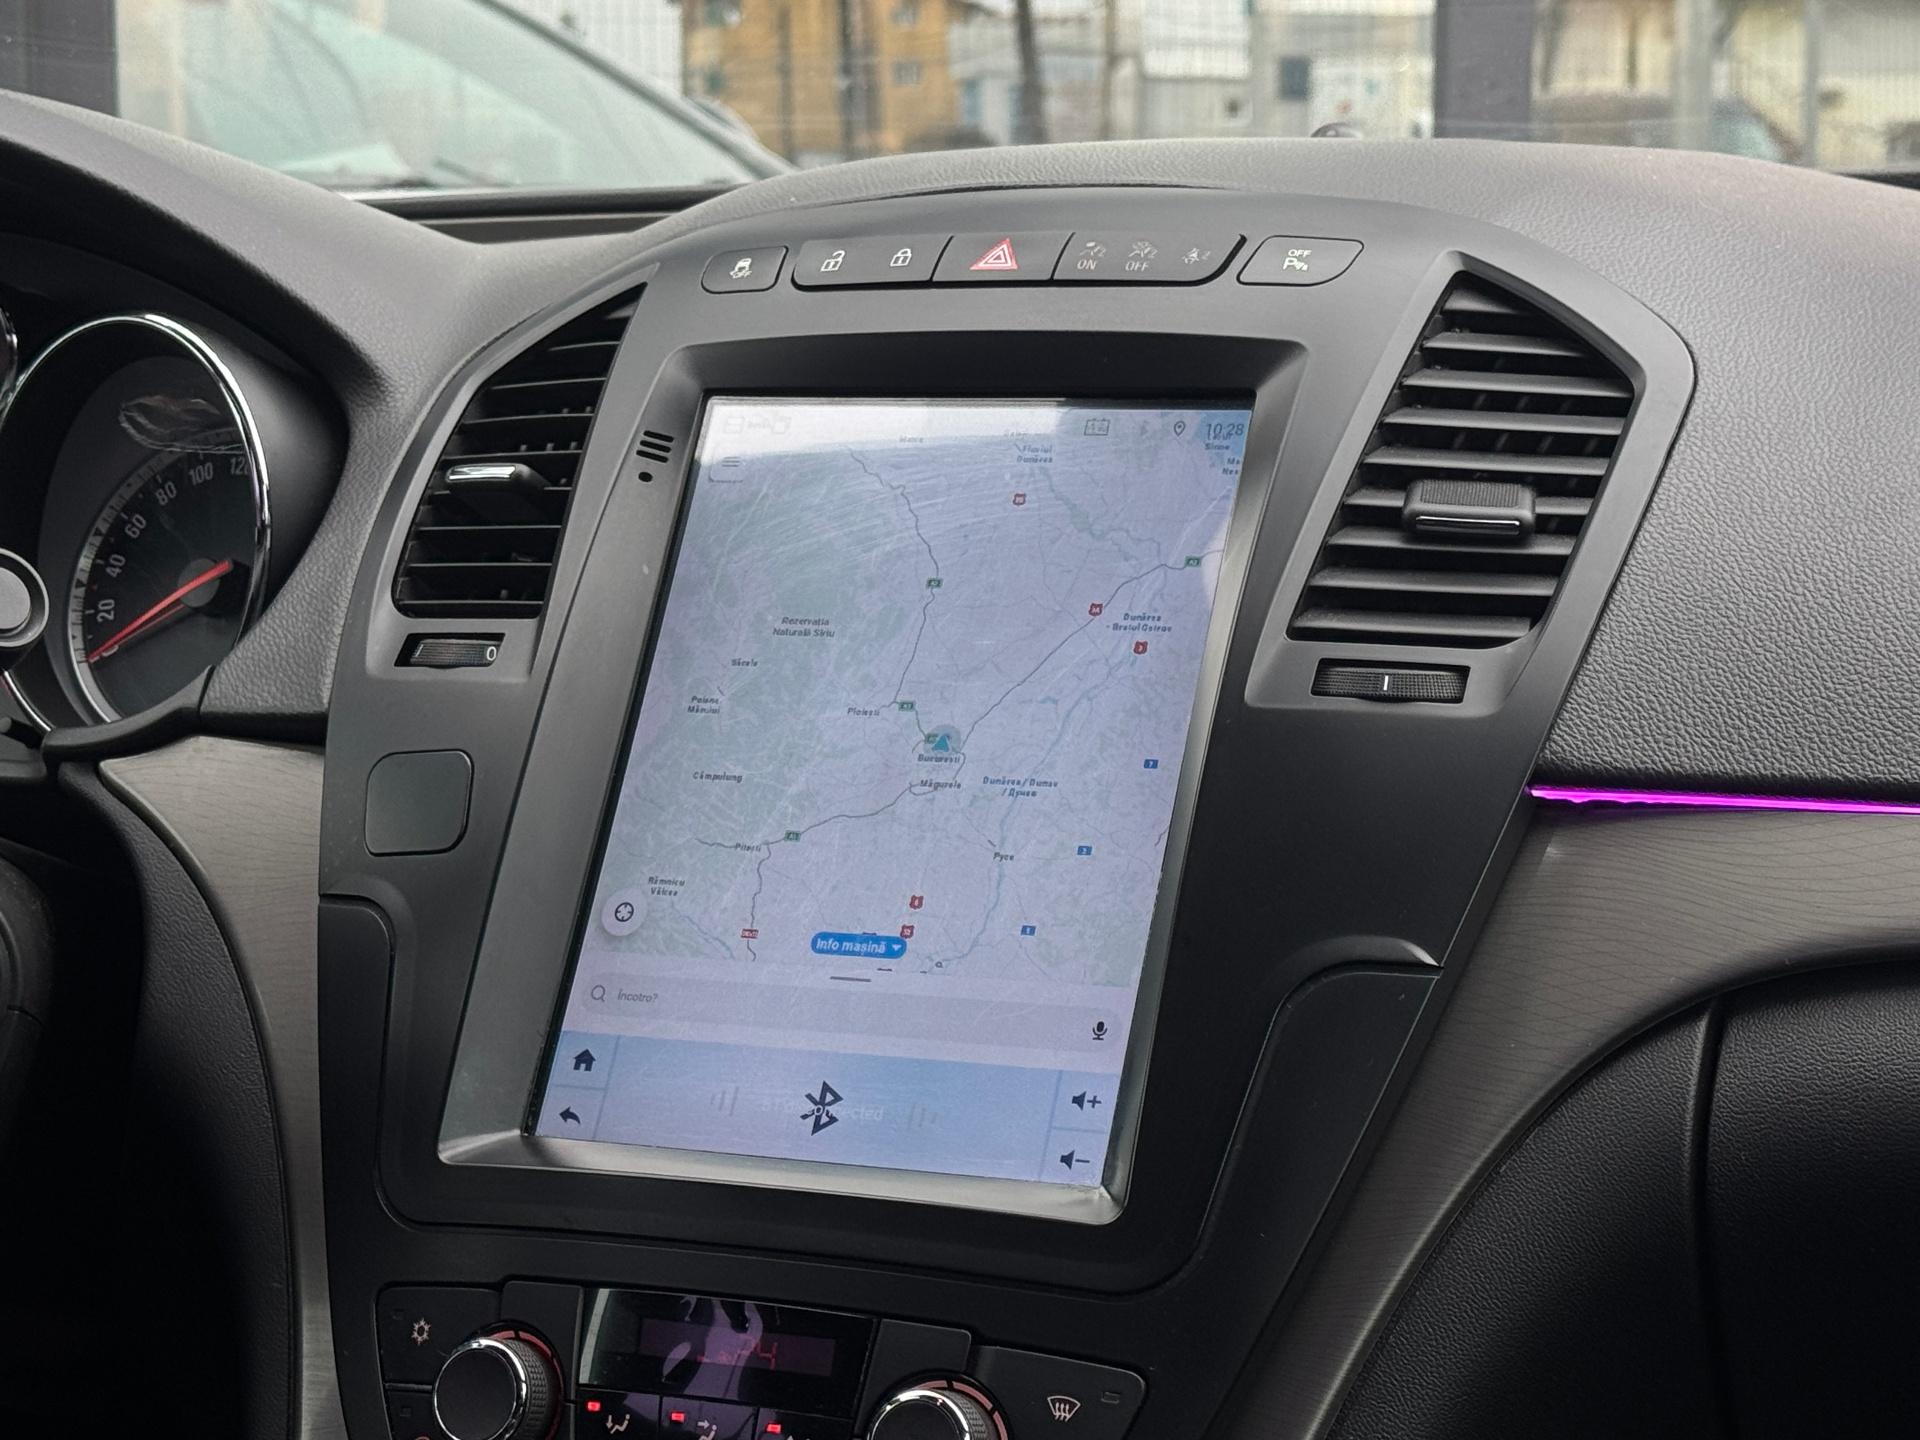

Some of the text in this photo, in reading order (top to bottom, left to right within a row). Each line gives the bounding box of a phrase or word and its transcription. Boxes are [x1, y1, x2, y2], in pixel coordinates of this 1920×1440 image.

[1077, 259, 1097, 270] ON
[1288, 249, 1312, 258] OFF
[1125, 261, 1149, 271] OFF
[188, 461, 214, 486] 100
[155, 480, 177, 506] 80
[124, 513, 147, 539] 60
[105, 553, 126, 578] 40
[97, 599, 115, 623] 20
[816, 938, 887, 955] Info mașină
